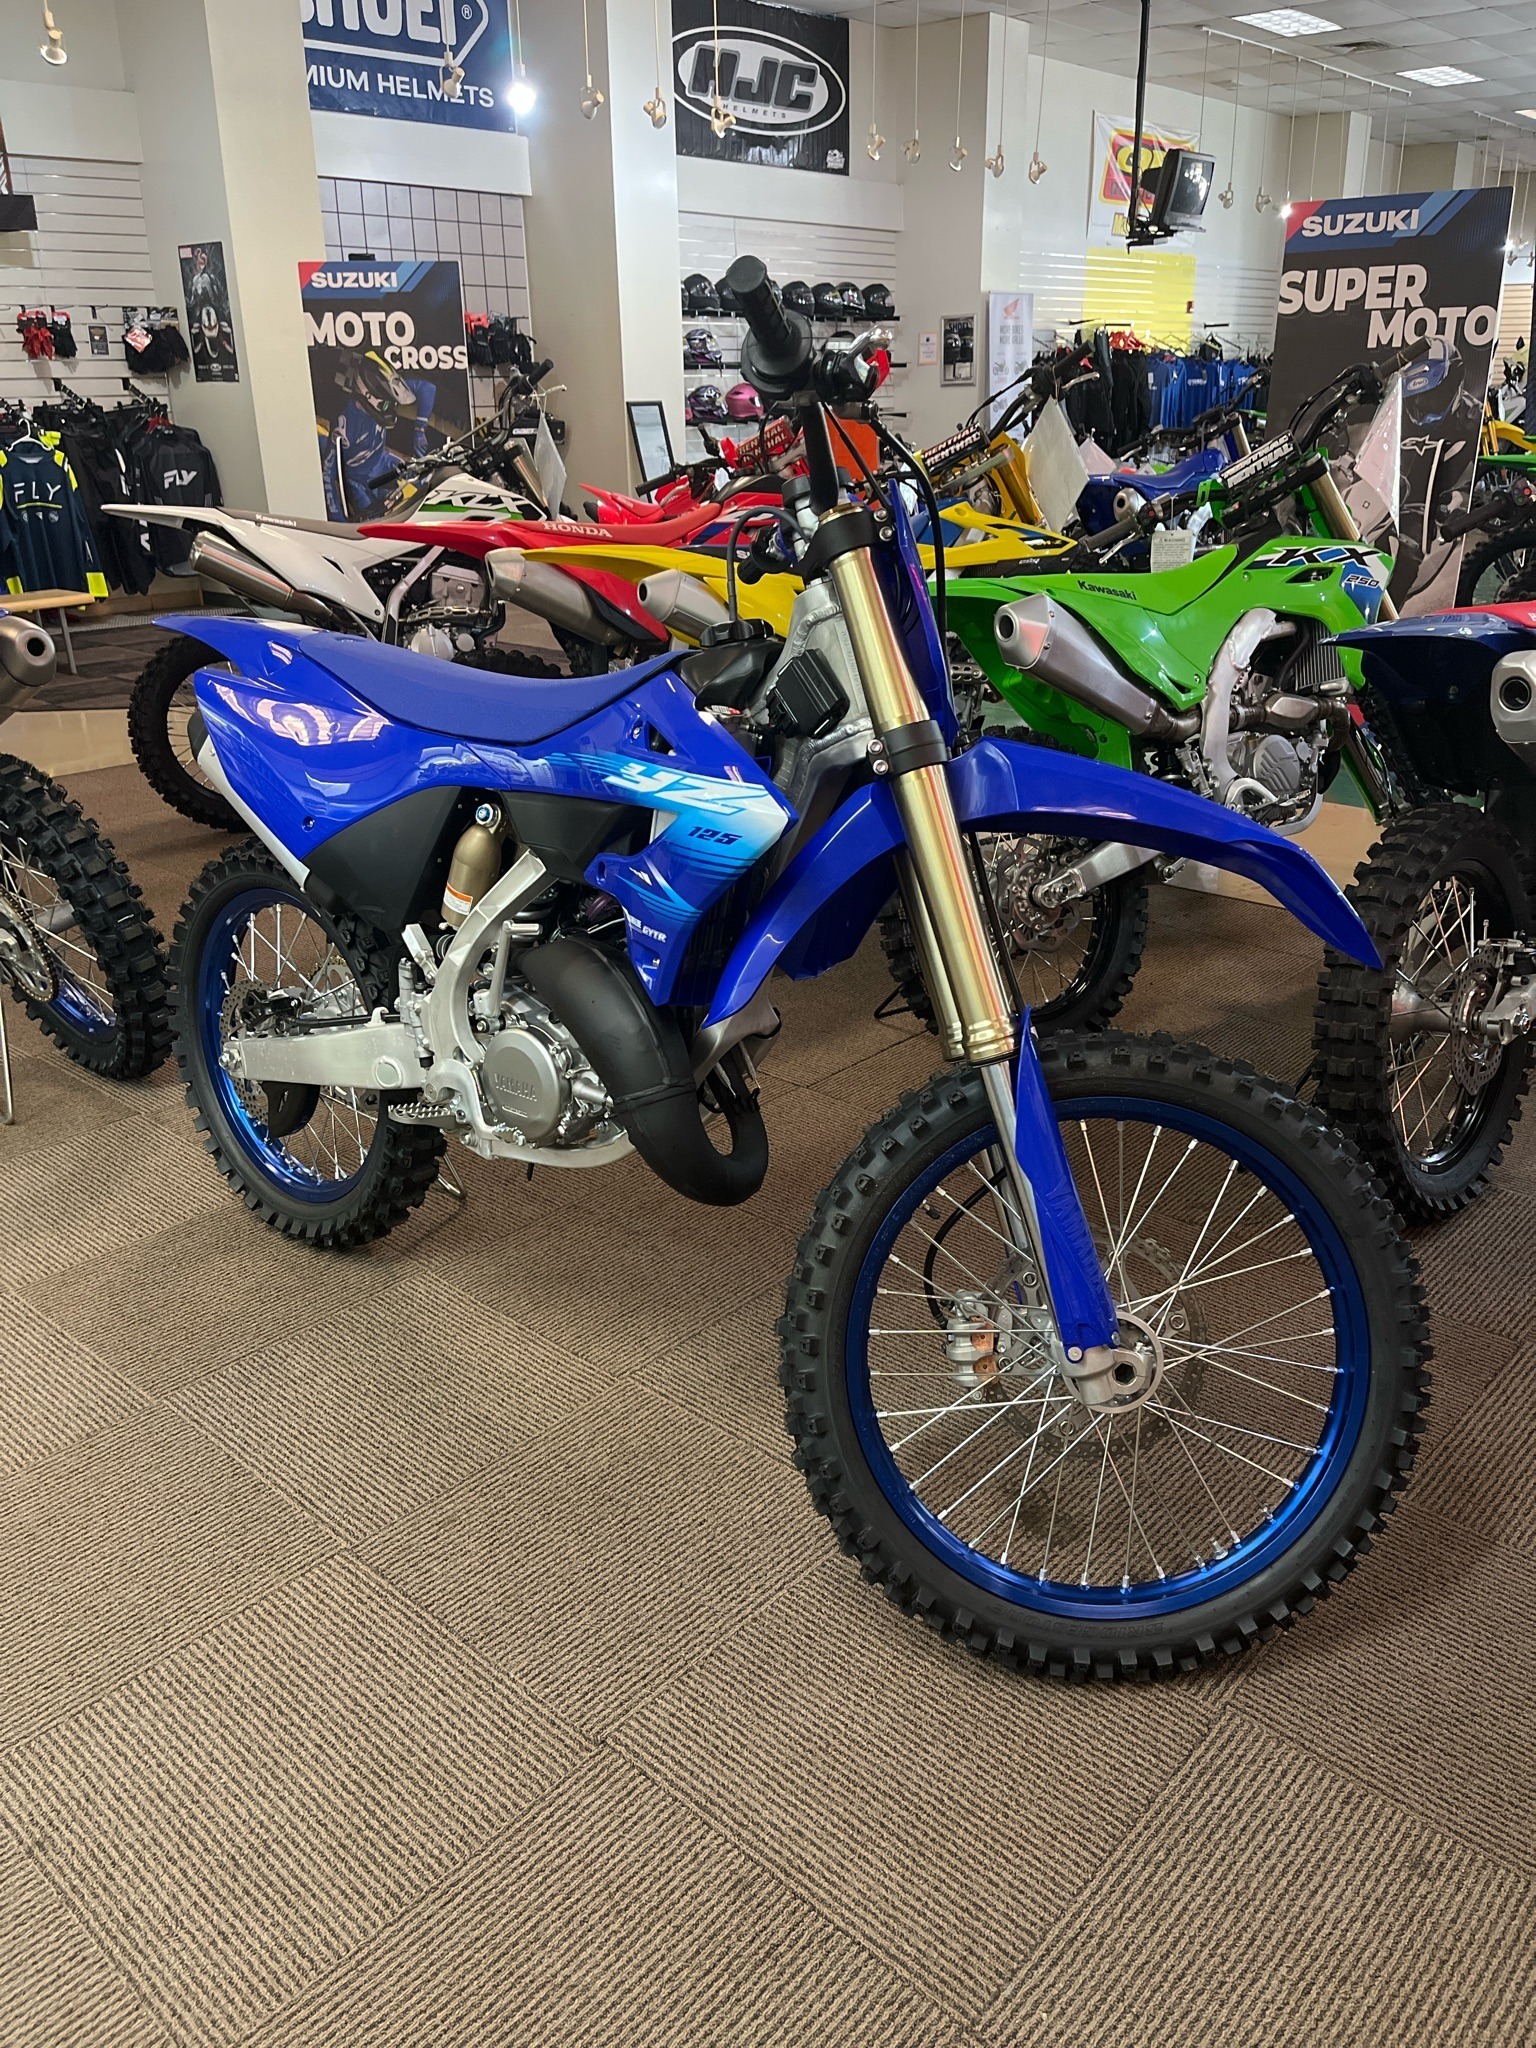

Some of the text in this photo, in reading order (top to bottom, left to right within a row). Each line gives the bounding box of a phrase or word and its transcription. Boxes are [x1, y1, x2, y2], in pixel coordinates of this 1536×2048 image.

[687, 44, 818, 113] HJC
[722, 103, 787, 119] HELMETS
[1301, 208, 1420, 238] SUZUKI
[311, 271, 398, 288] SUZUKI
[1278, 264, 1428, 315] SUPER
[303, 311, 415, 347] MOTO
[1366, 304, 1497, 349] MOTO
[384, 345, 468, 370] CROSS
[163, 469, 198, 489] FLY
[13, 481, 62, 503] FLY
[424, 490, 532, 514] KLX
[255, 514, 297, 527] Kawasaki
[543, 521, 613, 538] HONDA
[1268, 546, 1382, 567] KX
[1076, 579, 1138, 602] Kawasaki
[1345, 573, 1380, 589] 250
[602, 762, 770, 816] YZ
[688, 826, 743, 846] 125
[642, 925, 668, 943] GYTR
[494, 1072, 538, 1103] YAMAHA
